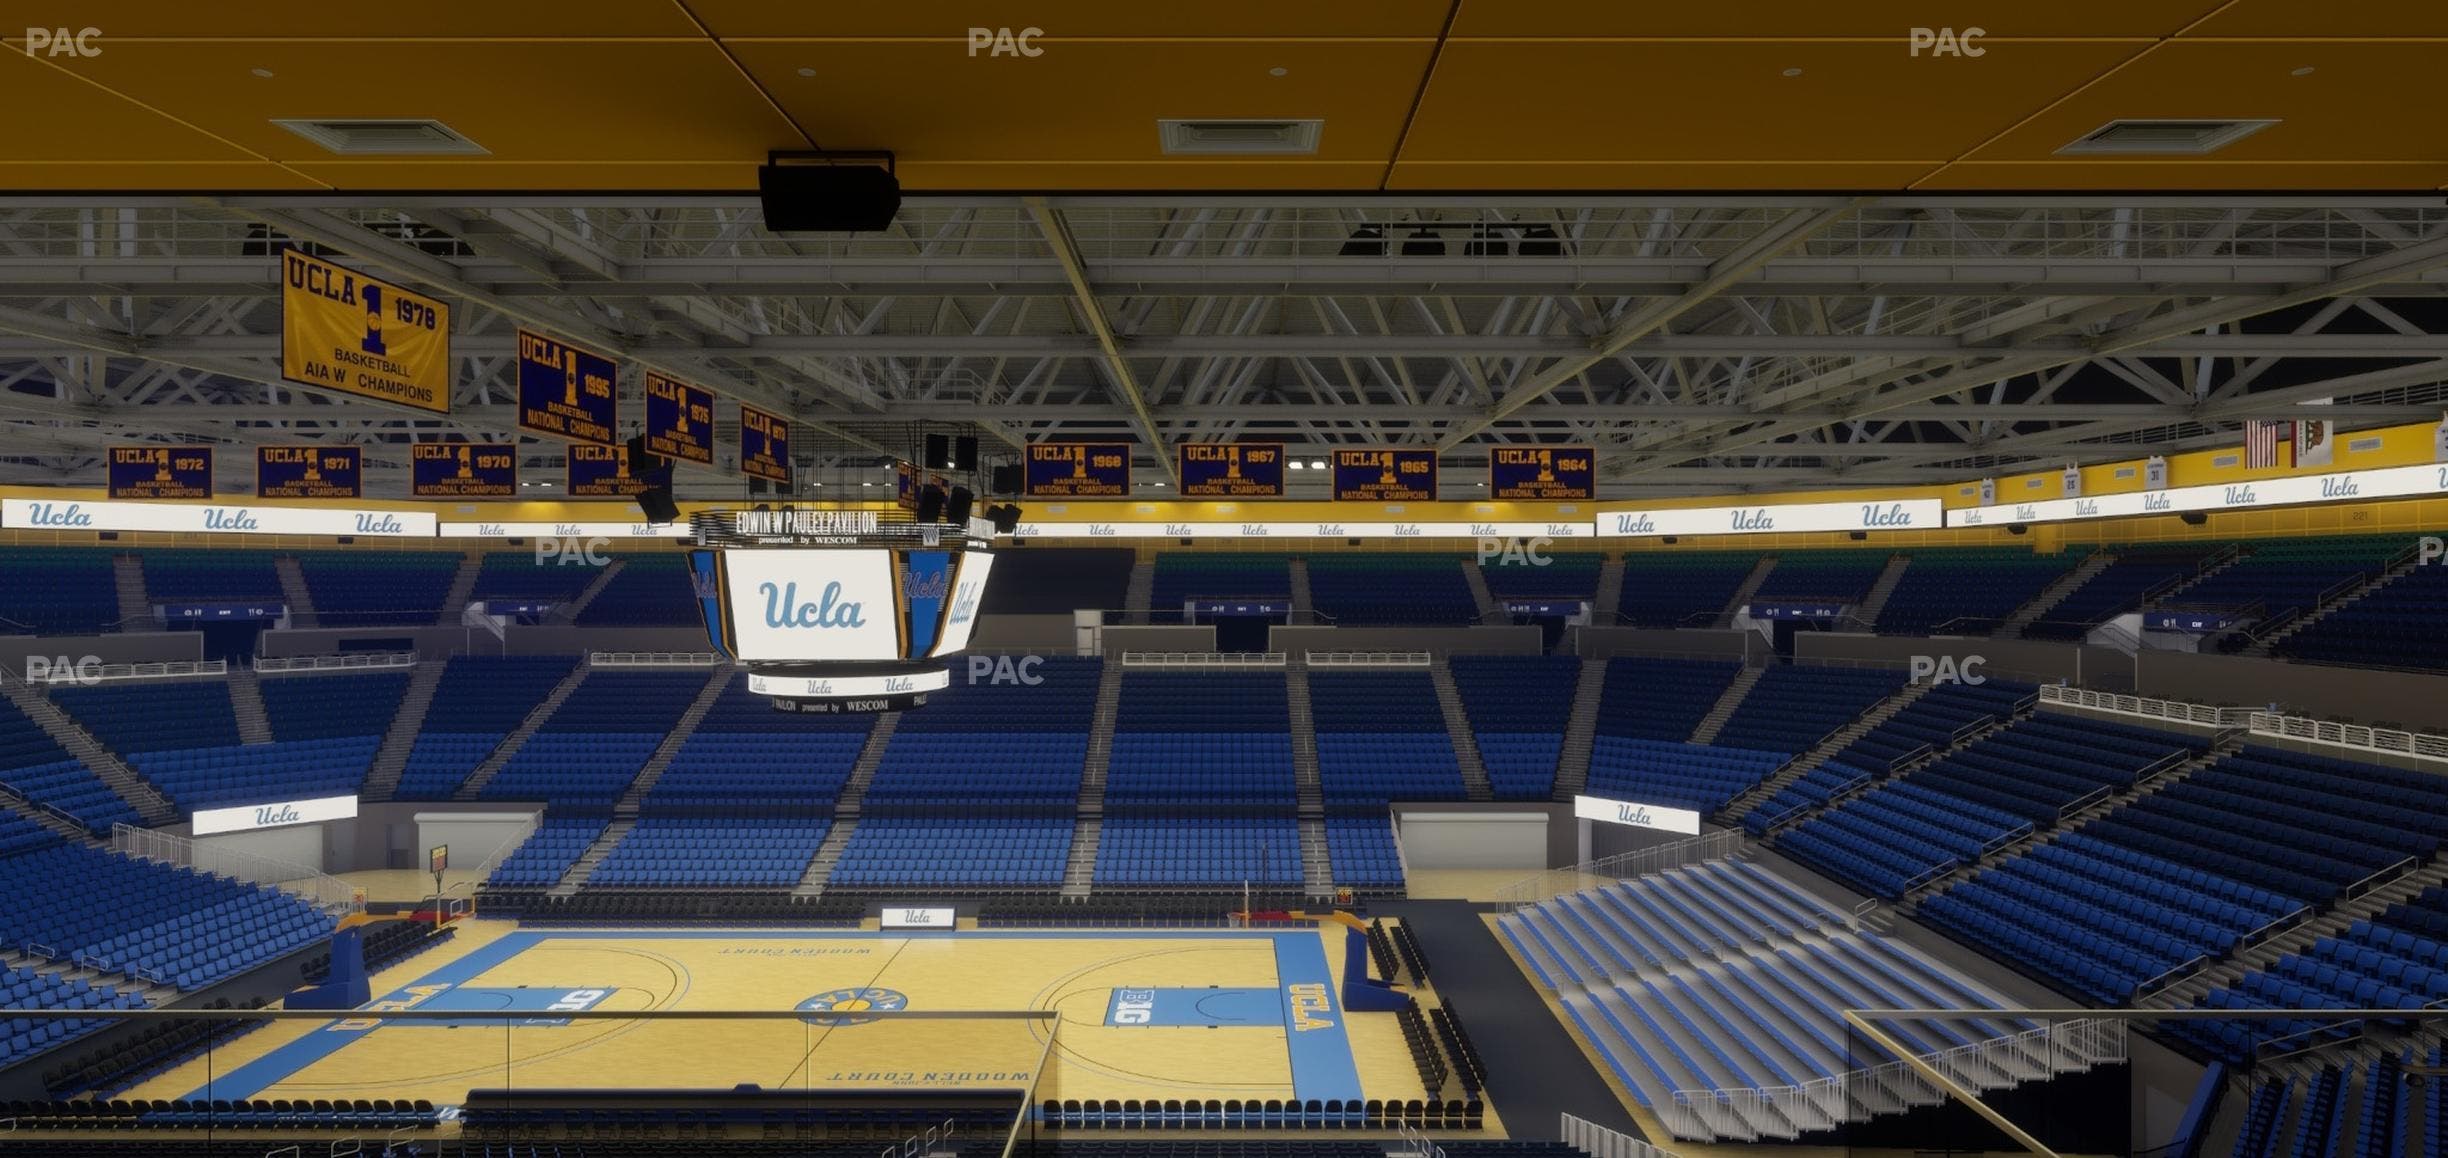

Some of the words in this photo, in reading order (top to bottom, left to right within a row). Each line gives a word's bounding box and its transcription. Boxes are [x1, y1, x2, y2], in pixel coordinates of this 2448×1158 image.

[288, 257, 357, 306] UCLA
[361, 284, 386, 356] 1
[396, 297, 435, 330] 1978
[521, 334, 562, 370] UCLA
[335, 348, 410, 378] BASKETBALL
[358, 374, 433, 402] CHAMPIONS
[584, 373, 611, 399] 1995
[647, 375, 676, 401] UCLA
[528, 408, 565, 432] NATIONAL
[115, 450, 155, 463] UCLA
[264, 450, 303, 463] UCLA
[415, 446, 451, 460] UCLA
[575, 446, 615, 460] UCLA
[1033, 446, 1072, 461] UCLA
[1187, 446, 1226, 460] UCLA
[1246, 450, 1275, 463] 1967
[1340, 452, 1380, 466] UCLA
[1498, 450, 1537, 464] UCLA
[175, 458, 204, 471] 1972
[324, 458, 350, 470] 1971
[476, 455, 511, 469] 1970
[1400, 461, 1429, 474] 1965
[1557, 458, 1587, 472] 1964
[116, 487, 154, 498] NATIONAL
[159, 487, 204, 498] CHAMPIONS
[265, 487, 302, 498] NATIONAL
[308, 487, 353, 498] CHAMPIONS
[417, 484, 456, 495] NATIONAL
[459, 484, 512, 495] CHAMPIONS
[575, 484, 613, 495] NATIONAL
[1034, 484, 1071, 495] NATIONAL
[1077, 484, 1121, 495] CHAMPIONS
[1188, 484, 1225, 495] NATIONAL
[1230, 484, 1275, 495] CHAMPIONS
[1499, 488, 1536, 498] NATIONAL
[1541, 488, 1586, 498] CHAMPIONS
[2321, 476, 2359, 498] Ucla
[1341, 490, 1378, 500] NATIONAL
[1384, 490, 1429, 500] CHAMPIONS
[2144, 493, 2170, 510] Ucla
[2225, 485, 2256, 505] Ucla
[29, 503, 92, 526] Ucla
[2016, 505, 2036, 520] Ucla
[2075, 499, 2098, 516] Ucla
[204, 508, 258, 530] Ucla
[736, 511, 770, 534] EDWIN
[772, 511, 784, 534] W
[785, 511, 826, 534] PAULEY
[827, 511, 877, 534] PAVILION
[1731, 509, 1774, 531] Ucla
[1862, 504, 1912, 527] Ucla
[1964, 510, 1982, 524] Ucla
[355, 513, 402, 533] Ucla
[479, 524, 505, 536] Ucla
[555, 524, 582, 536] Ucla
[632, 524, 658, 536] Ucla
[1089, 524, 1115, 536] Ucla
[1165, 524, 1192, 536] Ucla
[1242, 524, 1268, 536] Ucla
[1317, 524, 1344, 536] Ucla
[1394, 524, 1421, 536] Ucla
[1471, 524, 1497, 536] Ucla
[1547, 524, 1573, 536] Ucla
[1617, 514, 1655, 534] Ucla
[759, 536, 793, 545] presented
[801, 536, 810, 546] by
[815, 536, 857, 545] WESCOM
[759, 581, 866, 629] Ucla
[807, 680, 832, 694] Ucla
[885, 677, 913, 692] Ucla
[832, 704, 840, 714] by
[847, 700, 889, 712] WESCOM
[256, 805, 300, 825] Ucla
[1618, 804, 1651, 825] Ucla
[905, 910, 930, 924] Ucla
[1289, 984, 1334, 1031] UCLA
[827, 1072, 914, 1081] COURT
[923, 1072, 1030, 1081] WOODEN
